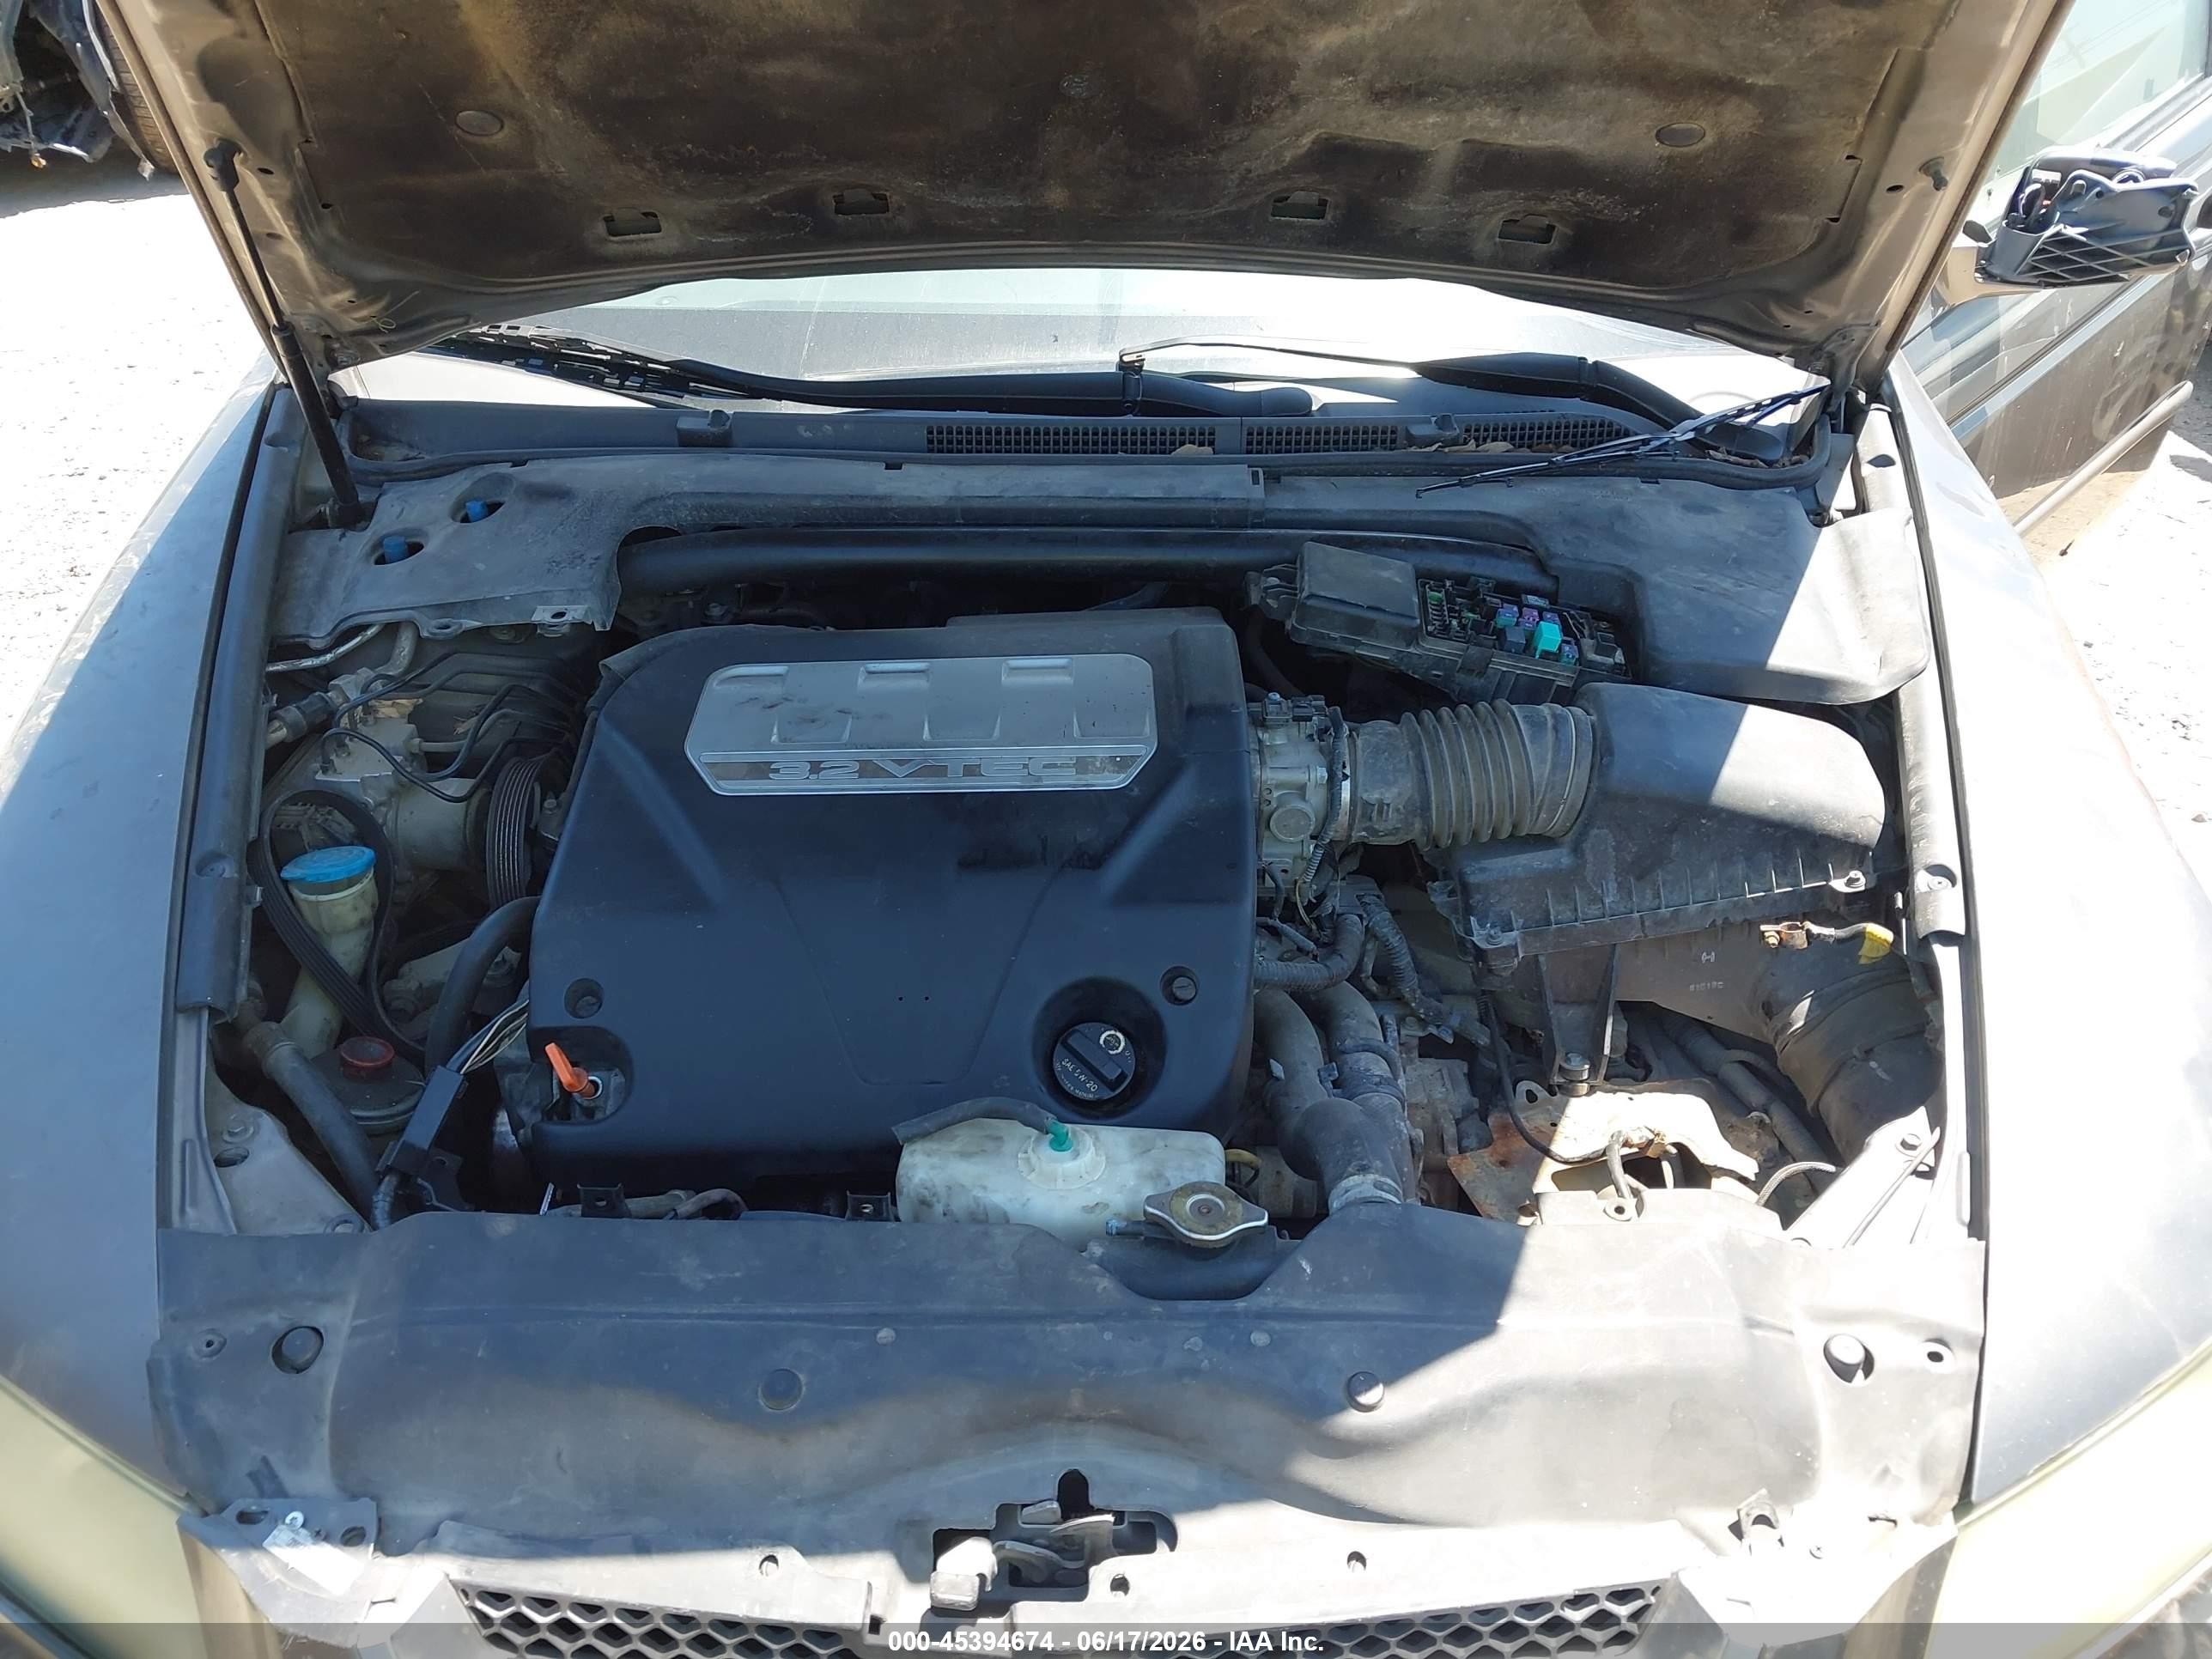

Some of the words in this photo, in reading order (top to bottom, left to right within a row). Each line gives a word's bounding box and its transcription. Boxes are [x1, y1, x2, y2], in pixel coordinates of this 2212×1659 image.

[769, 760, 859, 780] 3.2
[872, 757, 1077, 777] VTEC
[1061, 1058, 1075, 1072] SAE
